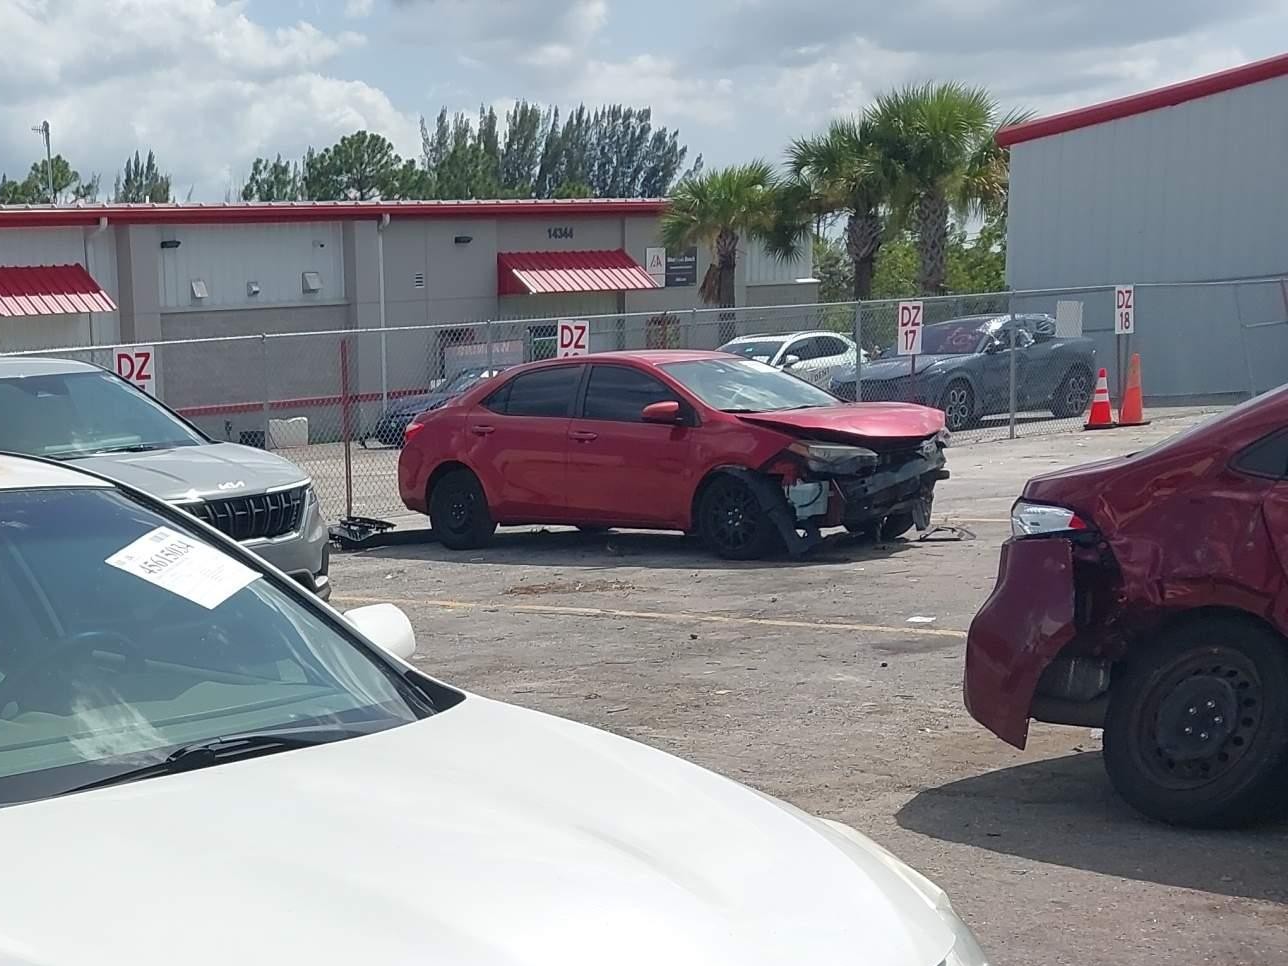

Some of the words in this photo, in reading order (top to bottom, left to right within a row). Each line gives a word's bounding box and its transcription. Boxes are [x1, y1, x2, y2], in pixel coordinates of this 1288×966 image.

[1116, 290, 1132, 309] DZ
[901, 305, 921, 327] DZ
[1119, 311, 1130, 330] 18
[560, 325, 586, 349] DZ
[904, 329, 917, 350] 17
[117, 352, 152, 380] DZ
[139, 539, 196, 575] 45615034
